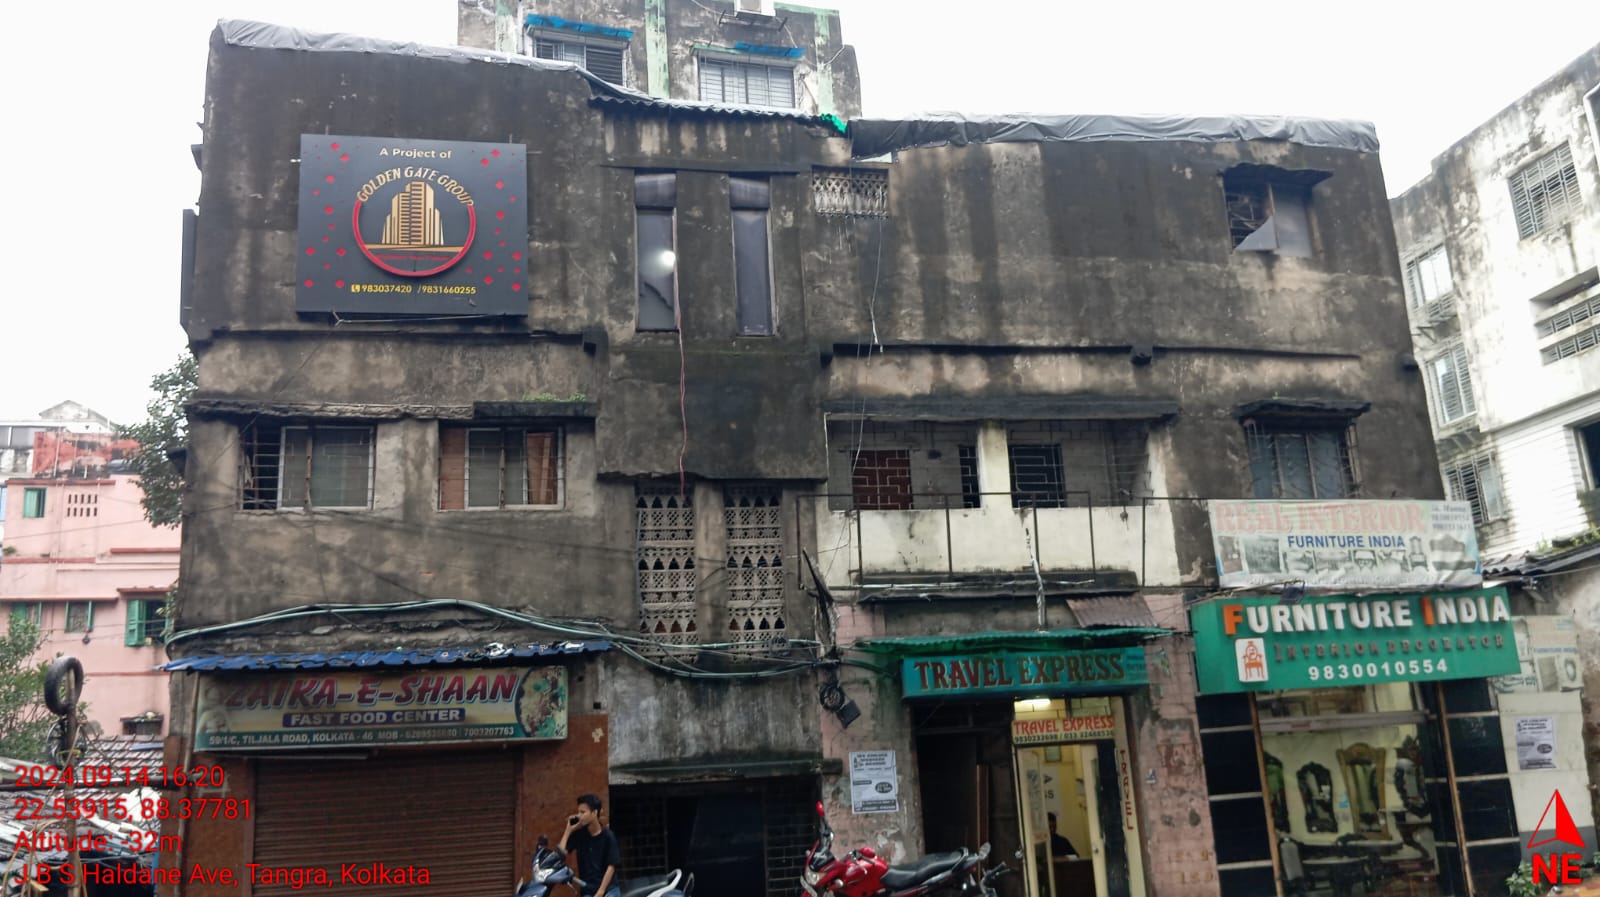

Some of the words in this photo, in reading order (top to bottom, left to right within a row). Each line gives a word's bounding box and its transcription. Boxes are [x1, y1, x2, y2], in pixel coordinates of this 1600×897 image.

[379, 147, 389, 156] A
[392, 148, 435, 159] Project
[438, 150, 453, 159] of
[356, 167, 401, 202] GOLDEN
[404, 166, 437, 182] GATE
[437, 174, 474, 206] GROUP
[361, 284, 413, 293] 983037420
[1214, 503, 1294, 534] REAL
[1297, 503, 1426, 534] INTERIOR
[1287, 535, 1364, 549] FURNITURE
[1368, 535, 1407, 548] INDIA
[1222, 600, 1414, 636] FURNITURE
[1420, 595, 1510, 626] INDIA
[1274, 641, 1380, 662] INTERIOR
[1387, 634, 1505, 652] DECORATOR
[913, 656, 1014, 690] TRAVEL
[1017, 653, 1125, 685] EXPRESS
[1308, 658, 1449, 681] 9830010554
[224, 674, 521, 708] ZAIKA-E-SHAAN
[290, 713, 333, 726] FAST
[339, 711, 386, 724] FOOD
[392, 709, 461, 722] CENTER
[1013, 720, 1060, 736] TRAVEL
[1062, 714, 1114, 731] EXPRESS
[242, 734, 281, 745] TILJALA
[282, 733, 311, 744] ROAD,
[312, 731, 355, 743] KOLKATA
[361, 731, 374, 740] 46
[378, 729, 398, 740] MOB
[1119, 749, 1134, 831] TRAVEL
